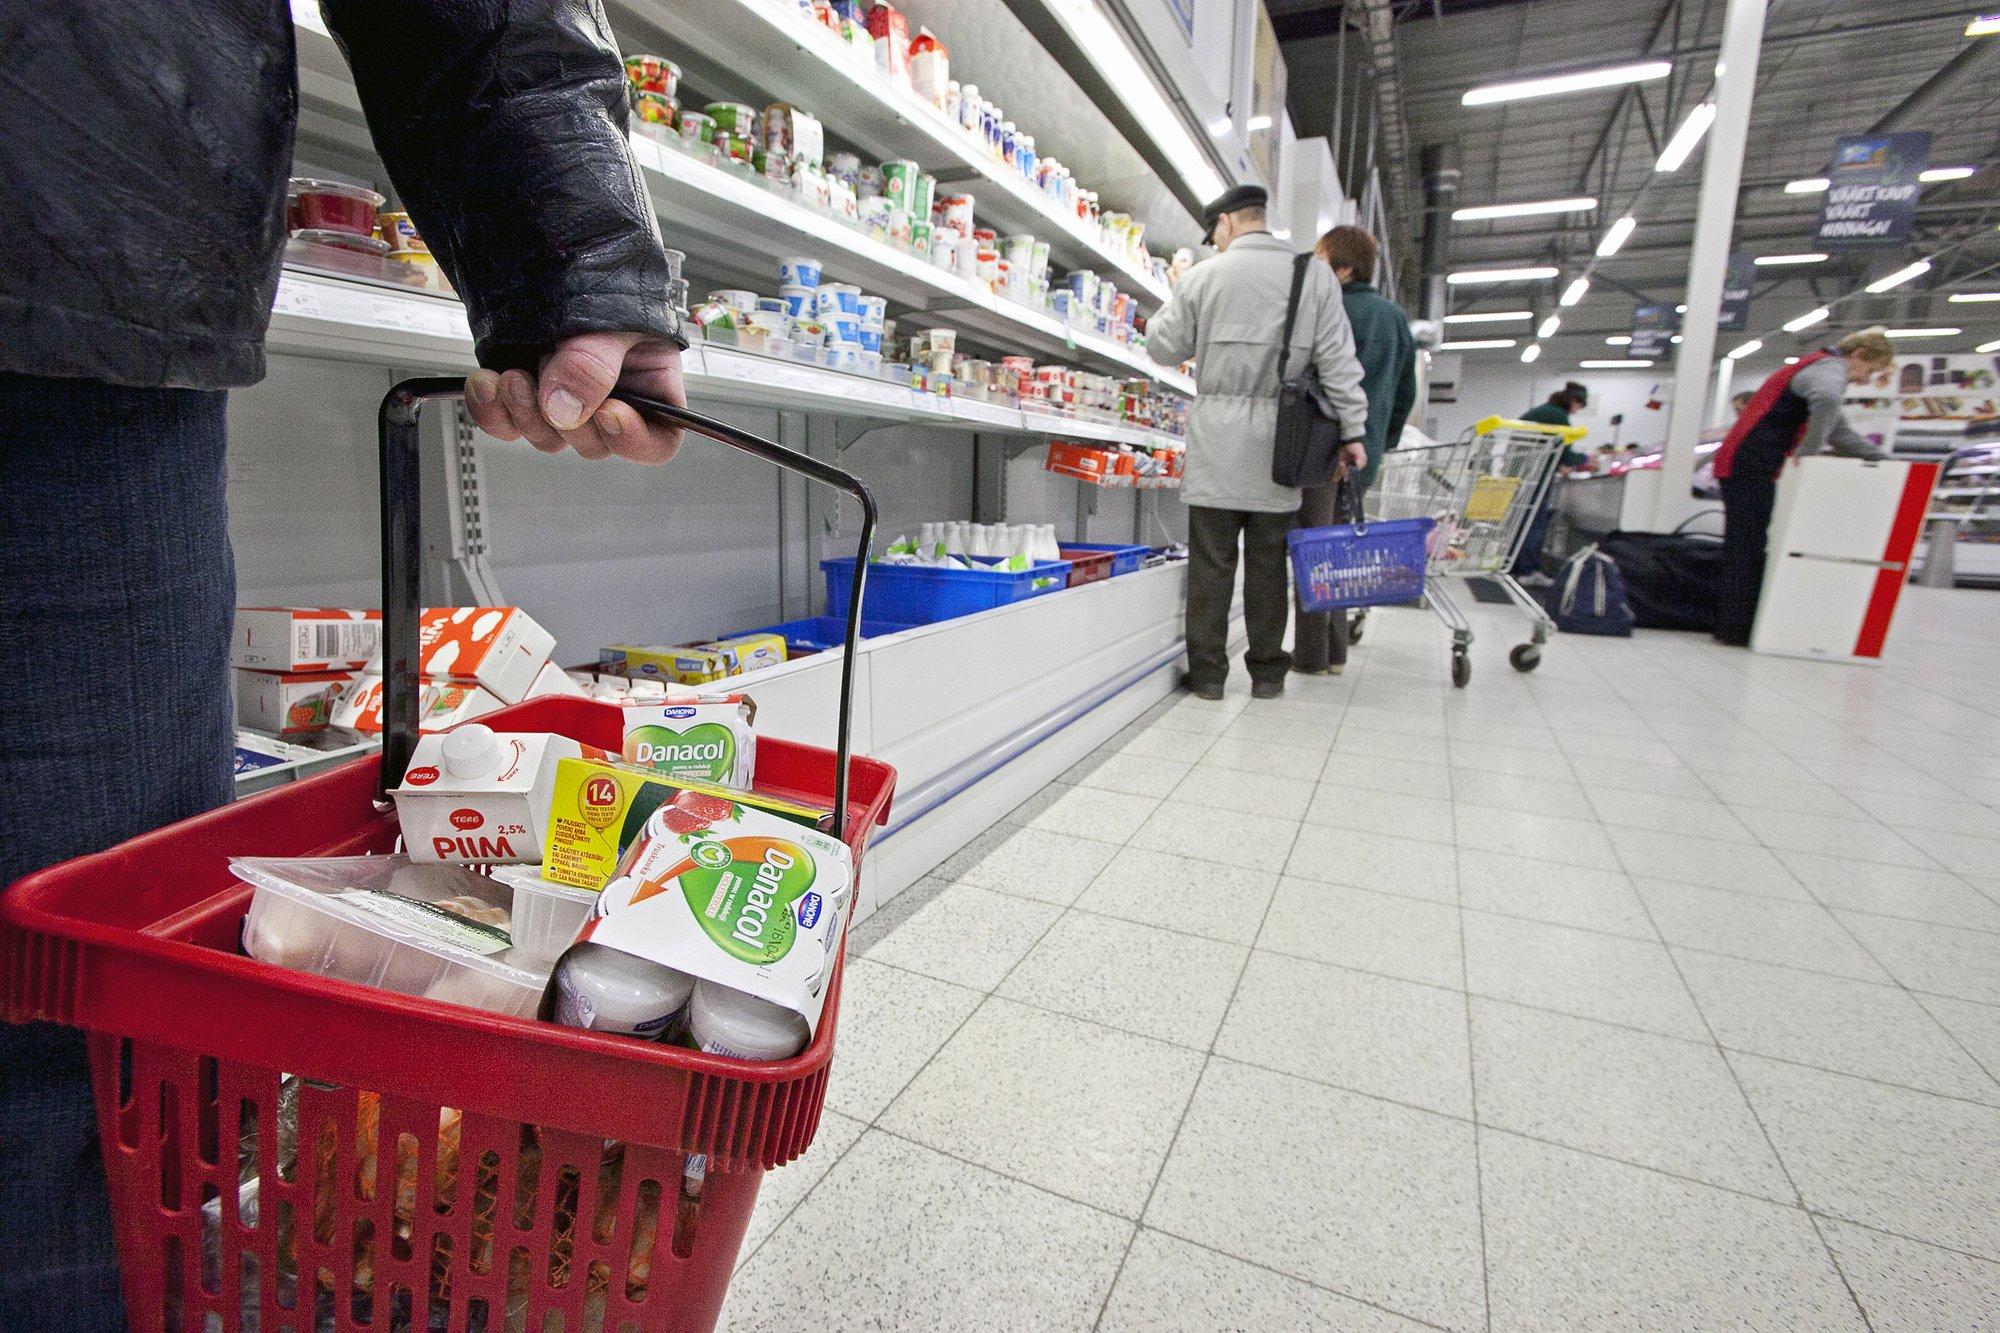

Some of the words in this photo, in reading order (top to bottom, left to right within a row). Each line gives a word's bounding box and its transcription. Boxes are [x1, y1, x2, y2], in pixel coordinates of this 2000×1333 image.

[665, 708, 695, 716] DANONE
[636, 740, 725, 763] Danacol
[409, 772, 436, 780] TERE
[589, 783, 613, 802] 14
[453, 815, 480, 825] TERE
[498, 825, 526, 836] 2,5%
[432, 836, 517, 860] PIIM
[640, 842, 667, 875] Truskawka
[732, 847, 795, 949] Danacol
[802, 894, 821, 928] DANONE
